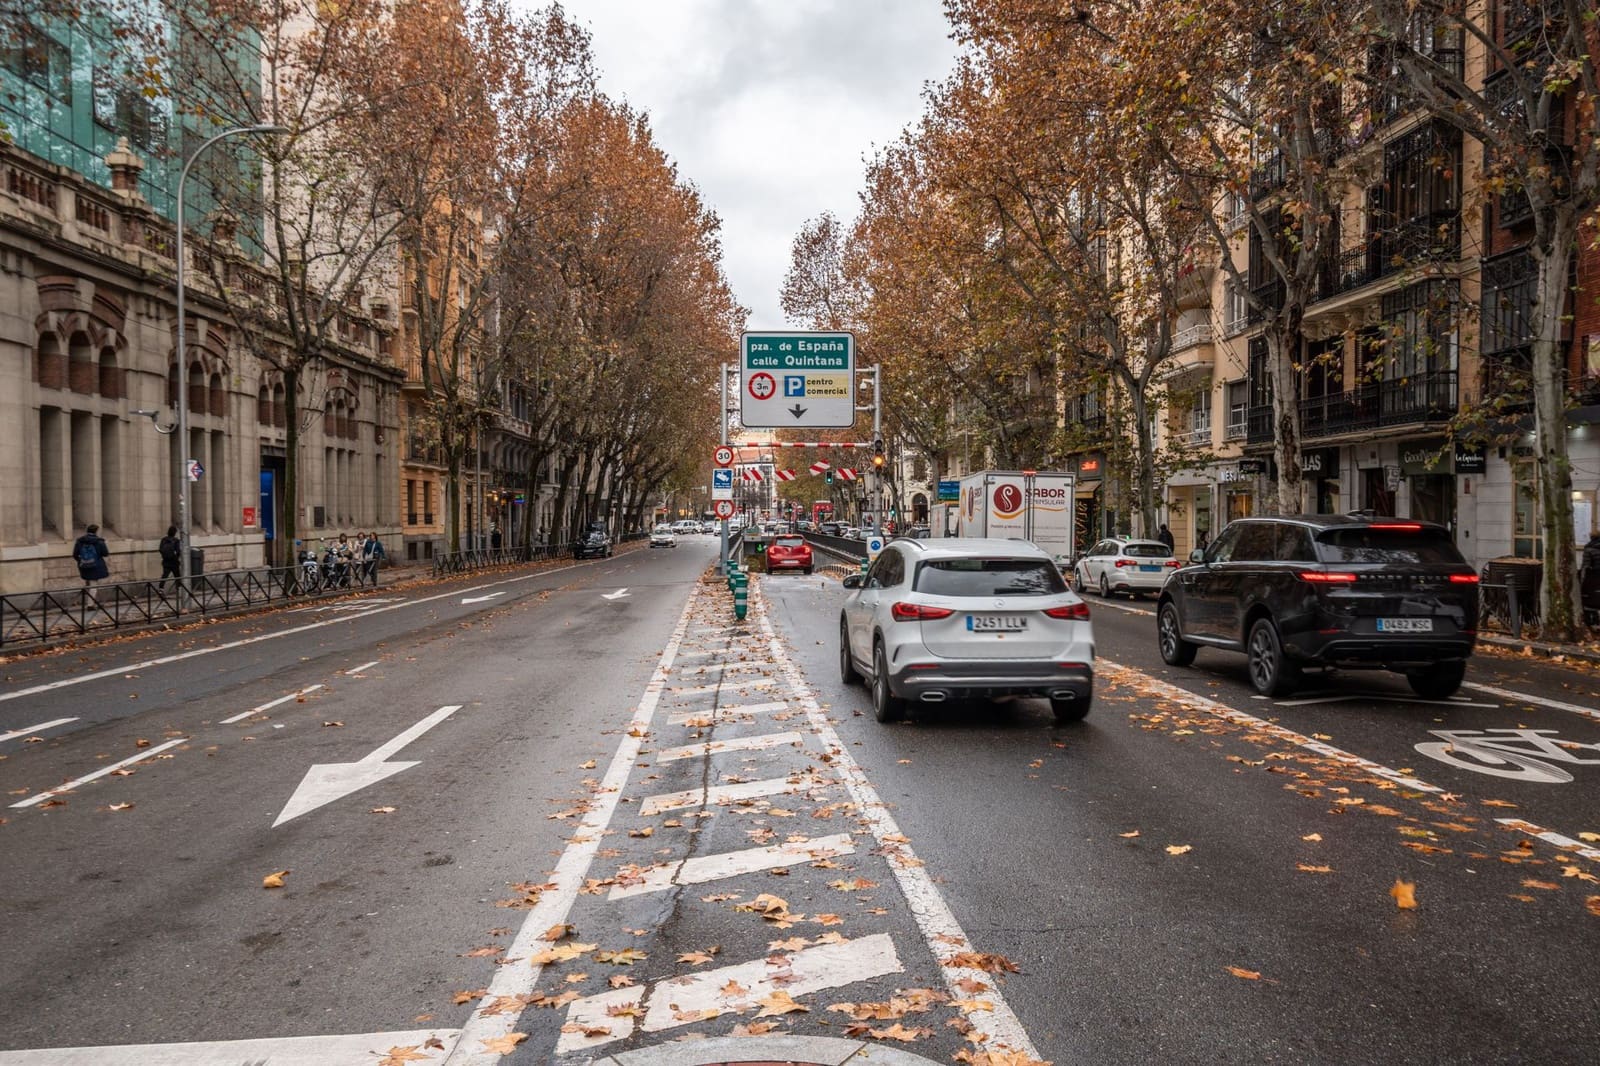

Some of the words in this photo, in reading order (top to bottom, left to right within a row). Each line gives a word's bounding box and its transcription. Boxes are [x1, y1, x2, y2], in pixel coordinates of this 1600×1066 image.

[751, 343, 773, 353] pza.
[779, 342, 792, 351] de
[798, 340, 844, 353] España
[752, 357, 779, 366] calle
[785, 355, 843, 367] Quintana
[788, 377, 802, 395] P
[806, 387, 847, 395] comercial
[718, 452, 730, 460] 30
[975, 617, 1002, 629] 2451
